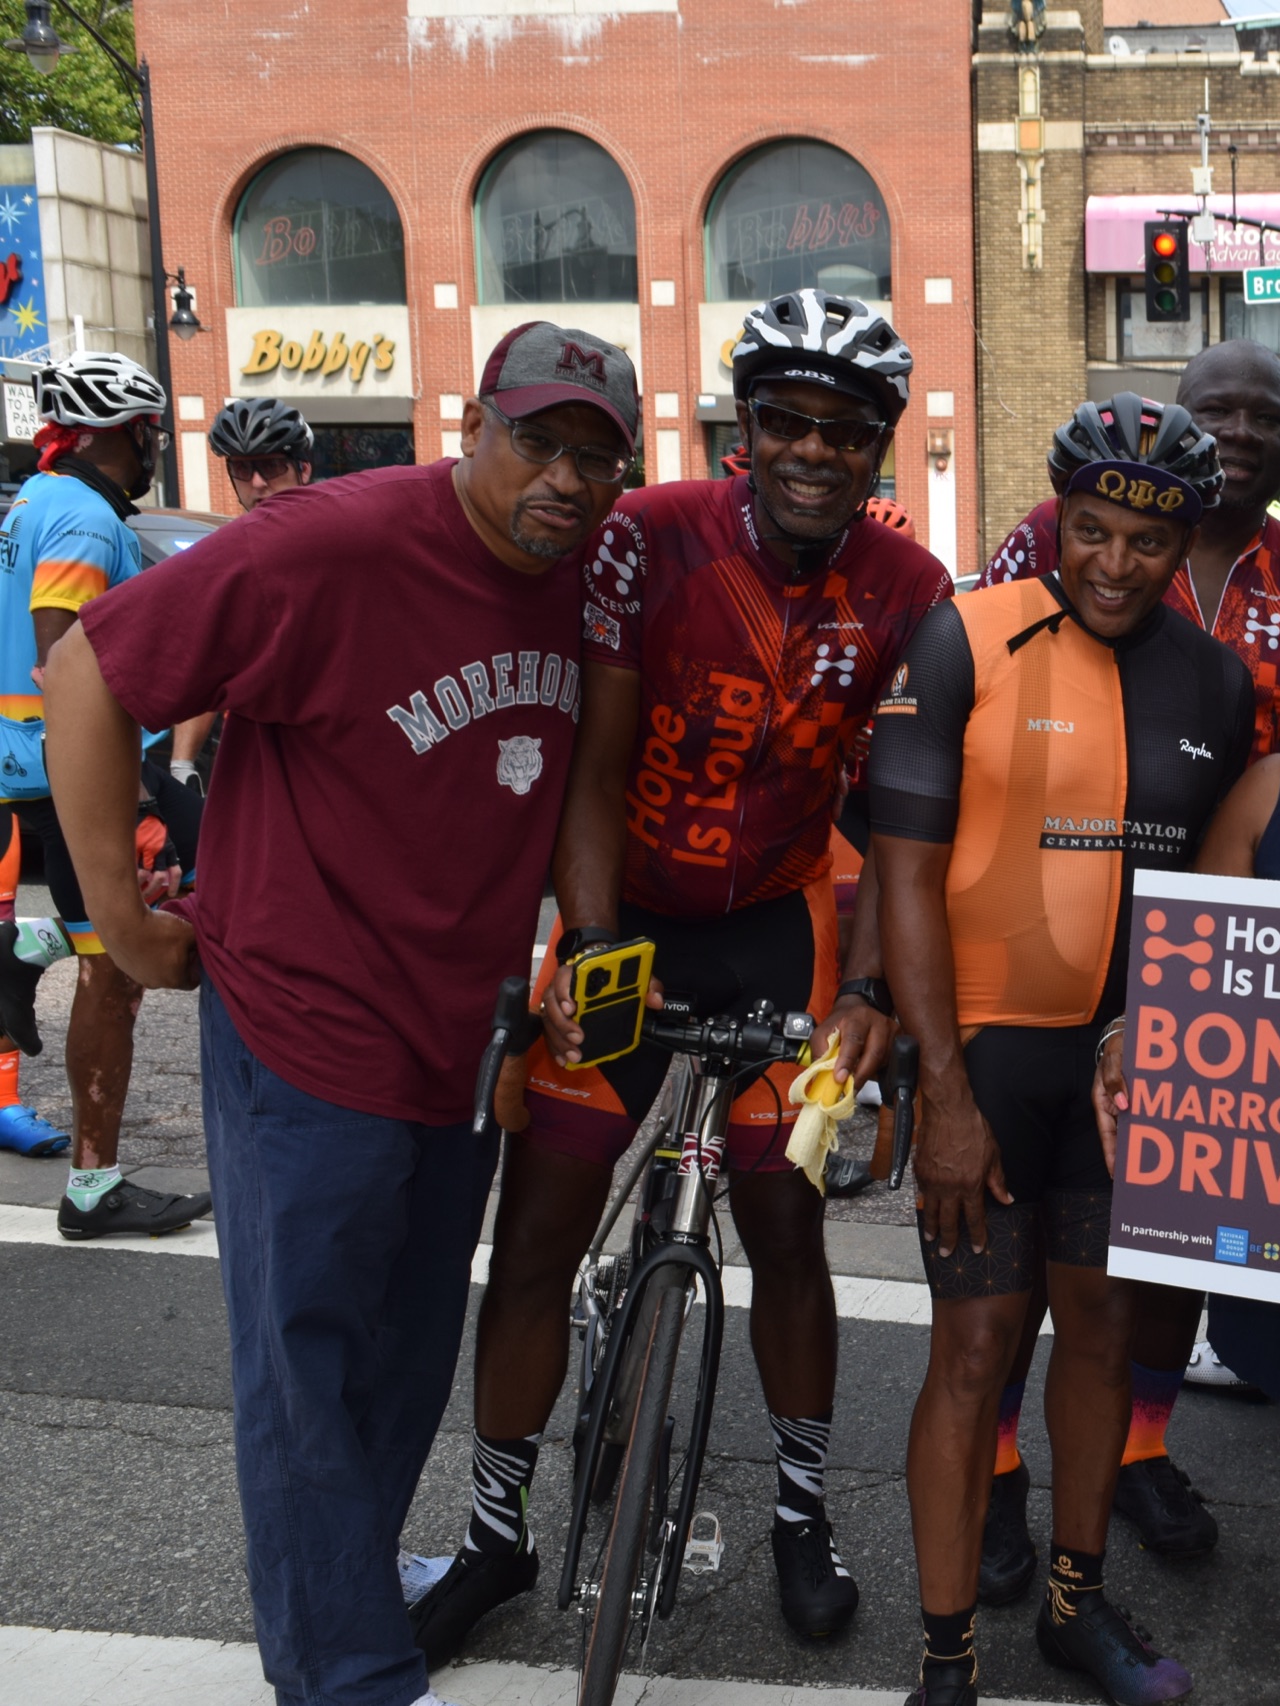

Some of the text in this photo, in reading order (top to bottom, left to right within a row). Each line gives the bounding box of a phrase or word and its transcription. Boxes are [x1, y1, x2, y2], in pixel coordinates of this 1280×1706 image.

[240, 329, 395, 382] Bobby's
[1027, 718, 1075, 734] MTCJ
[626, 704, 694, 849] Hope
[671, 671, 766, 868] Is Loud
[1043, 816, 1187, 840] MAJOR TAYLOR
[1046, 837, 1181, 854] CENTRAL JERSEY
[1222, 959, 1254, 997] Is
[1120, 1222, 1213, 1245] In partnership with
[1249, 1244, 1262, 1254] BE
